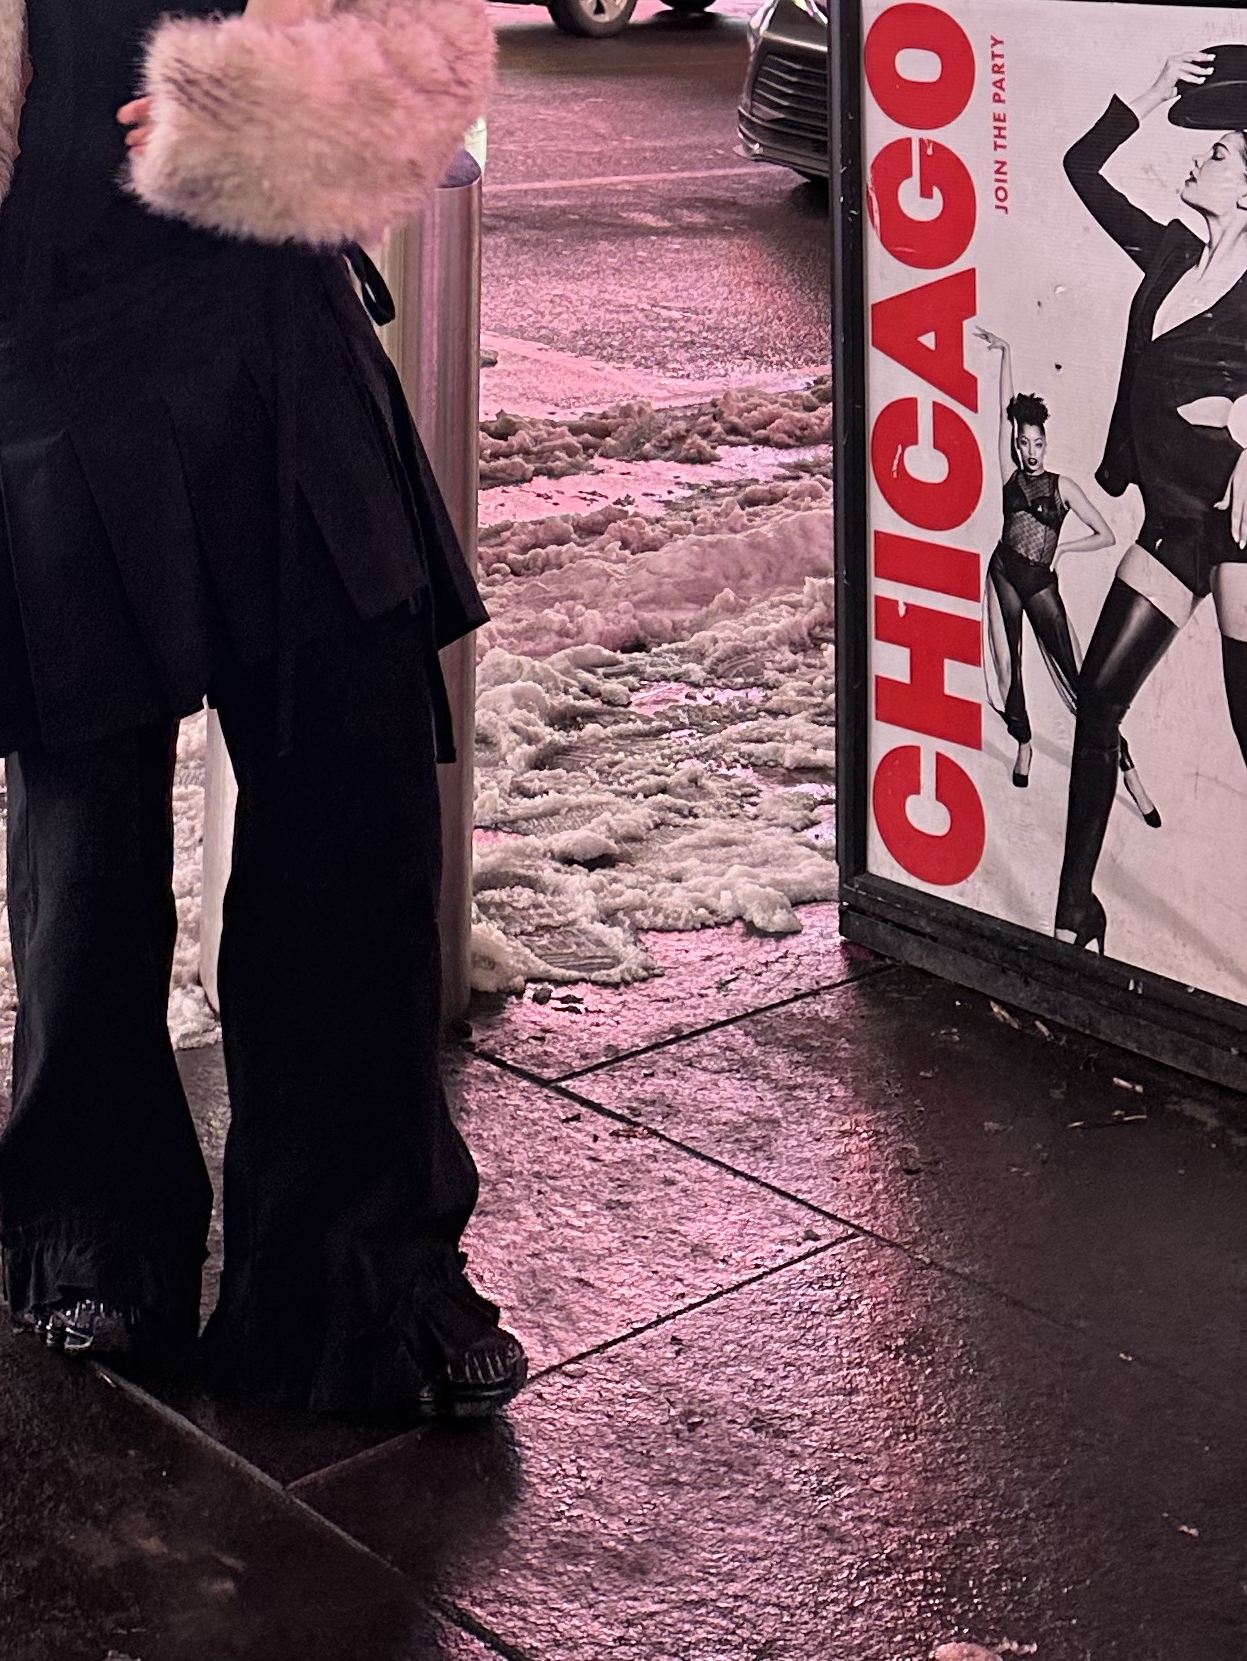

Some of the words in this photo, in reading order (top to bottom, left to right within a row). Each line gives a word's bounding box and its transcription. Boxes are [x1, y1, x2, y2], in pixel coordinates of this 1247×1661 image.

[990, 35, 1006, 105] PARTY
[993, 112, 1007, 152] THE
[994, 159, 1009, 215] JOIN
[864, 2, 986, 886] CHICAGO
